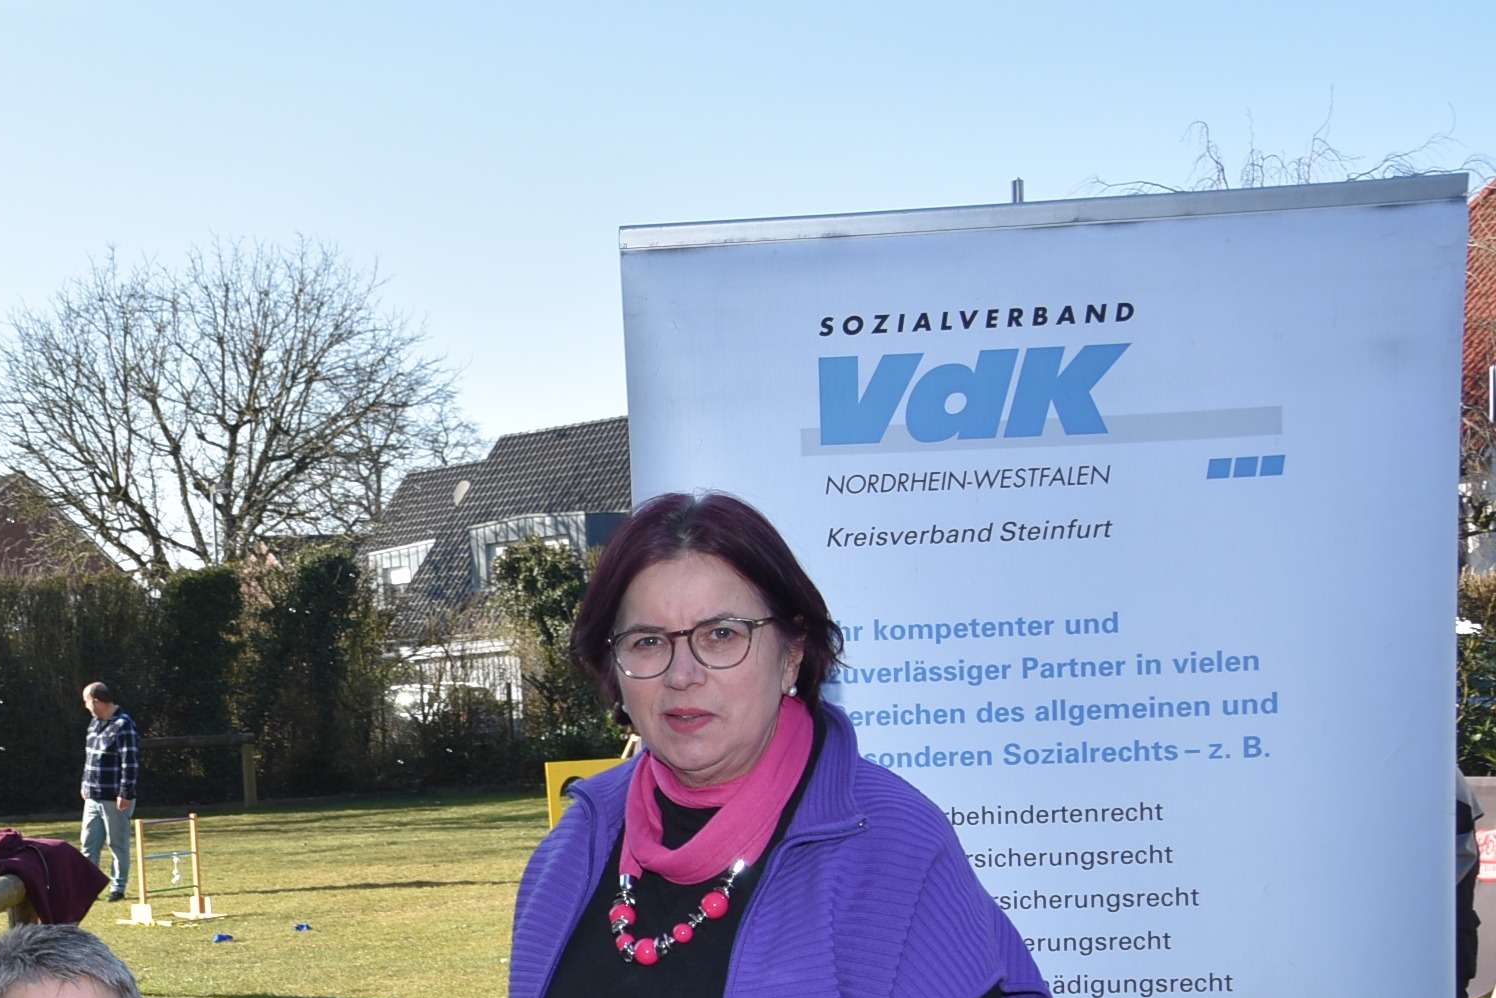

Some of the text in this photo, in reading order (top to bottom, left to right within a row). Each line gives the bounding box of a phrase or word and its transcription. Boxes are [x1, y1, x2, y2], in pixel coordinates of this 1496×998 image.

[818, 302, 1136, 337] SOZIALVERBAND
[817, 343, 1132, 446] VdK
[824, 464, 1112, 496] NORDRHEIN-WESTFALEN
[826, 518, 1113, 549] Kreisverband Steinfurt
[835, 611, 1120, 645] hr kompetenter und
[1021, 655, 1126, 681] Partner
[1136, 653, 1162, 677] in
[1172, 649, 1260, 675] vielen
[841, 691, 1279, 729] ereichen des allgemeinen und
[862, 745, 993, 768] sonderen
[1003, 739, 1179, 766] Sozialrechts
[1207, 742, 1232, 760] z.
[1242, 736, 1272, 759] B.
[1022, 930, 1172, 956] erungsrecht
